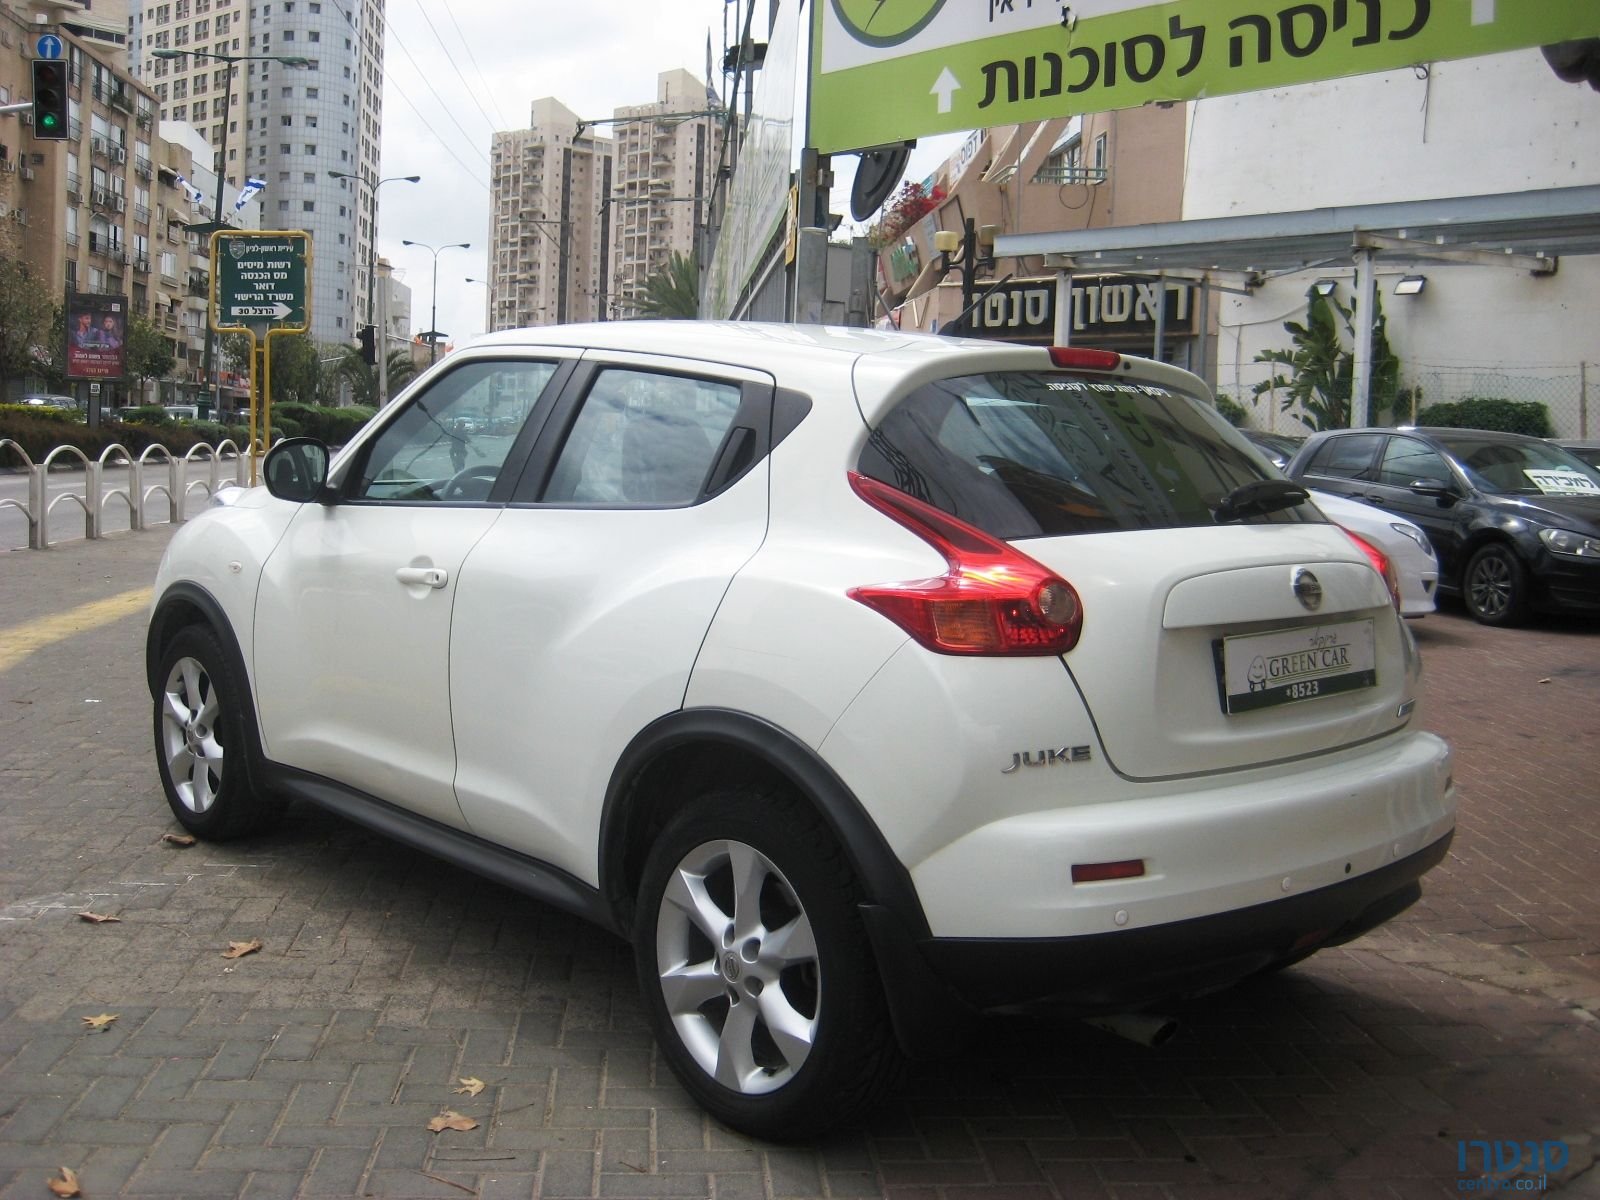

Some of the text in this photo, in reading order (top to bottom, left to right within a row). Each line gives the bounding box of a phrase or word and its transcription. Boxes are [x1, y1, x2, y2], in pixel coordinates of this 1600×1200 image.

[978, 0, 1431, 108] כניסה לסוכנות
[237, 261, 291, 270] רשות מיסים
[240, 272, 271, 280] הכנסה
[253, 282, 275, 290] דואר
[234, 293, 264, 301] הרישוי
[252, 306, 275, 315] הרצל
[1072, 281, 1189, 330] ראשון
[1532, 475, 1594, 488] למכירה
[1269, 647, 1350, 677] GREEN CAR
[1001, 745, 1092, 774] JUKE
